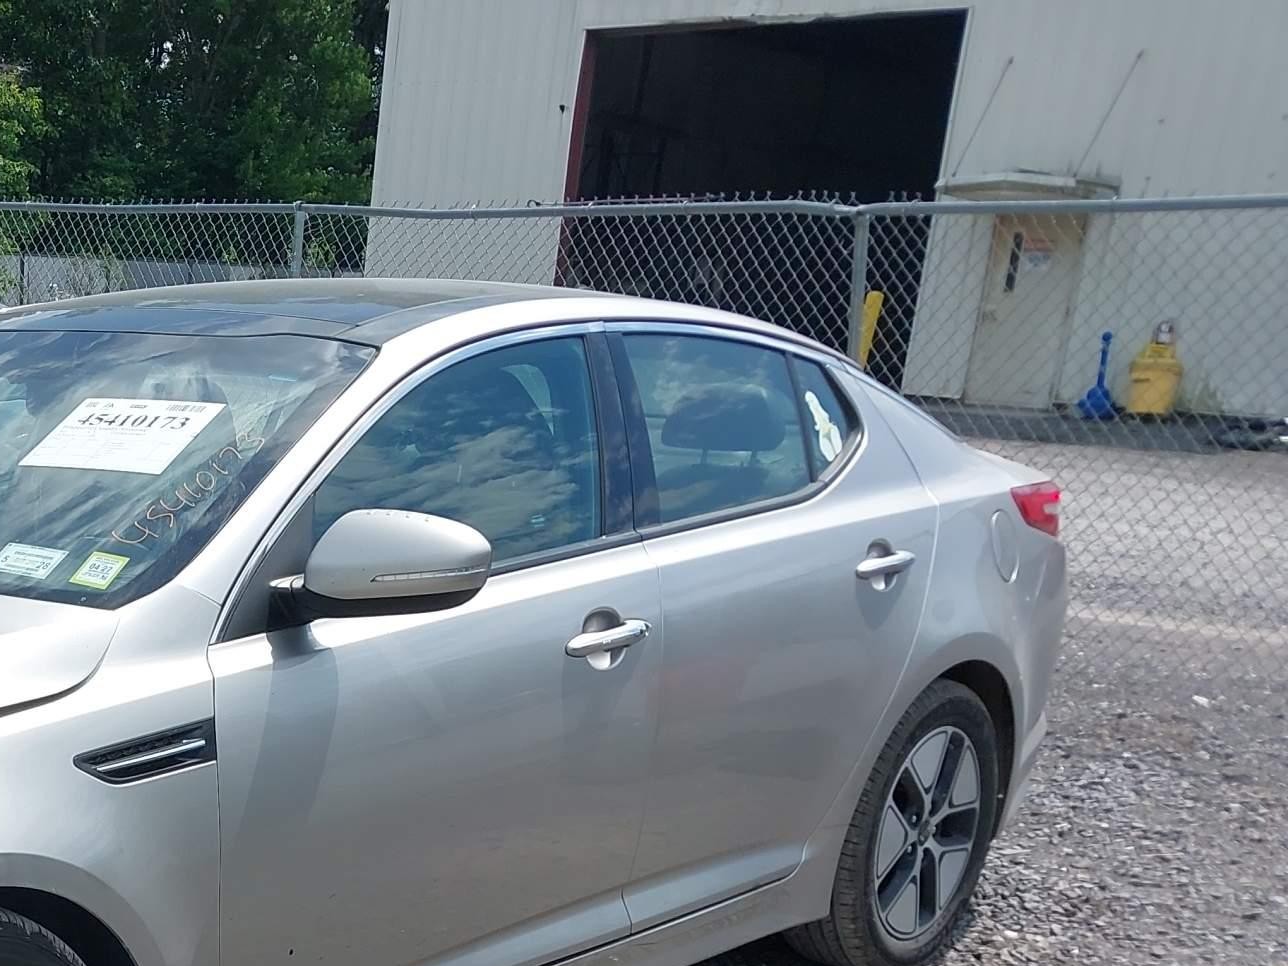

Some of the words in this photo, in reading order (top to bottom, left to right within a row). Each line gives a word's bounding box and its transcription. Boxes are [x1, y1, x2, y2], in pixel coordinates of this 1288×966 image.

[78, 413, 190, 429] 45410173
[112, 432, 265, 544] 45410173
[1, 555, 10, 563] 5
[35, 561, 50, 570] 28
